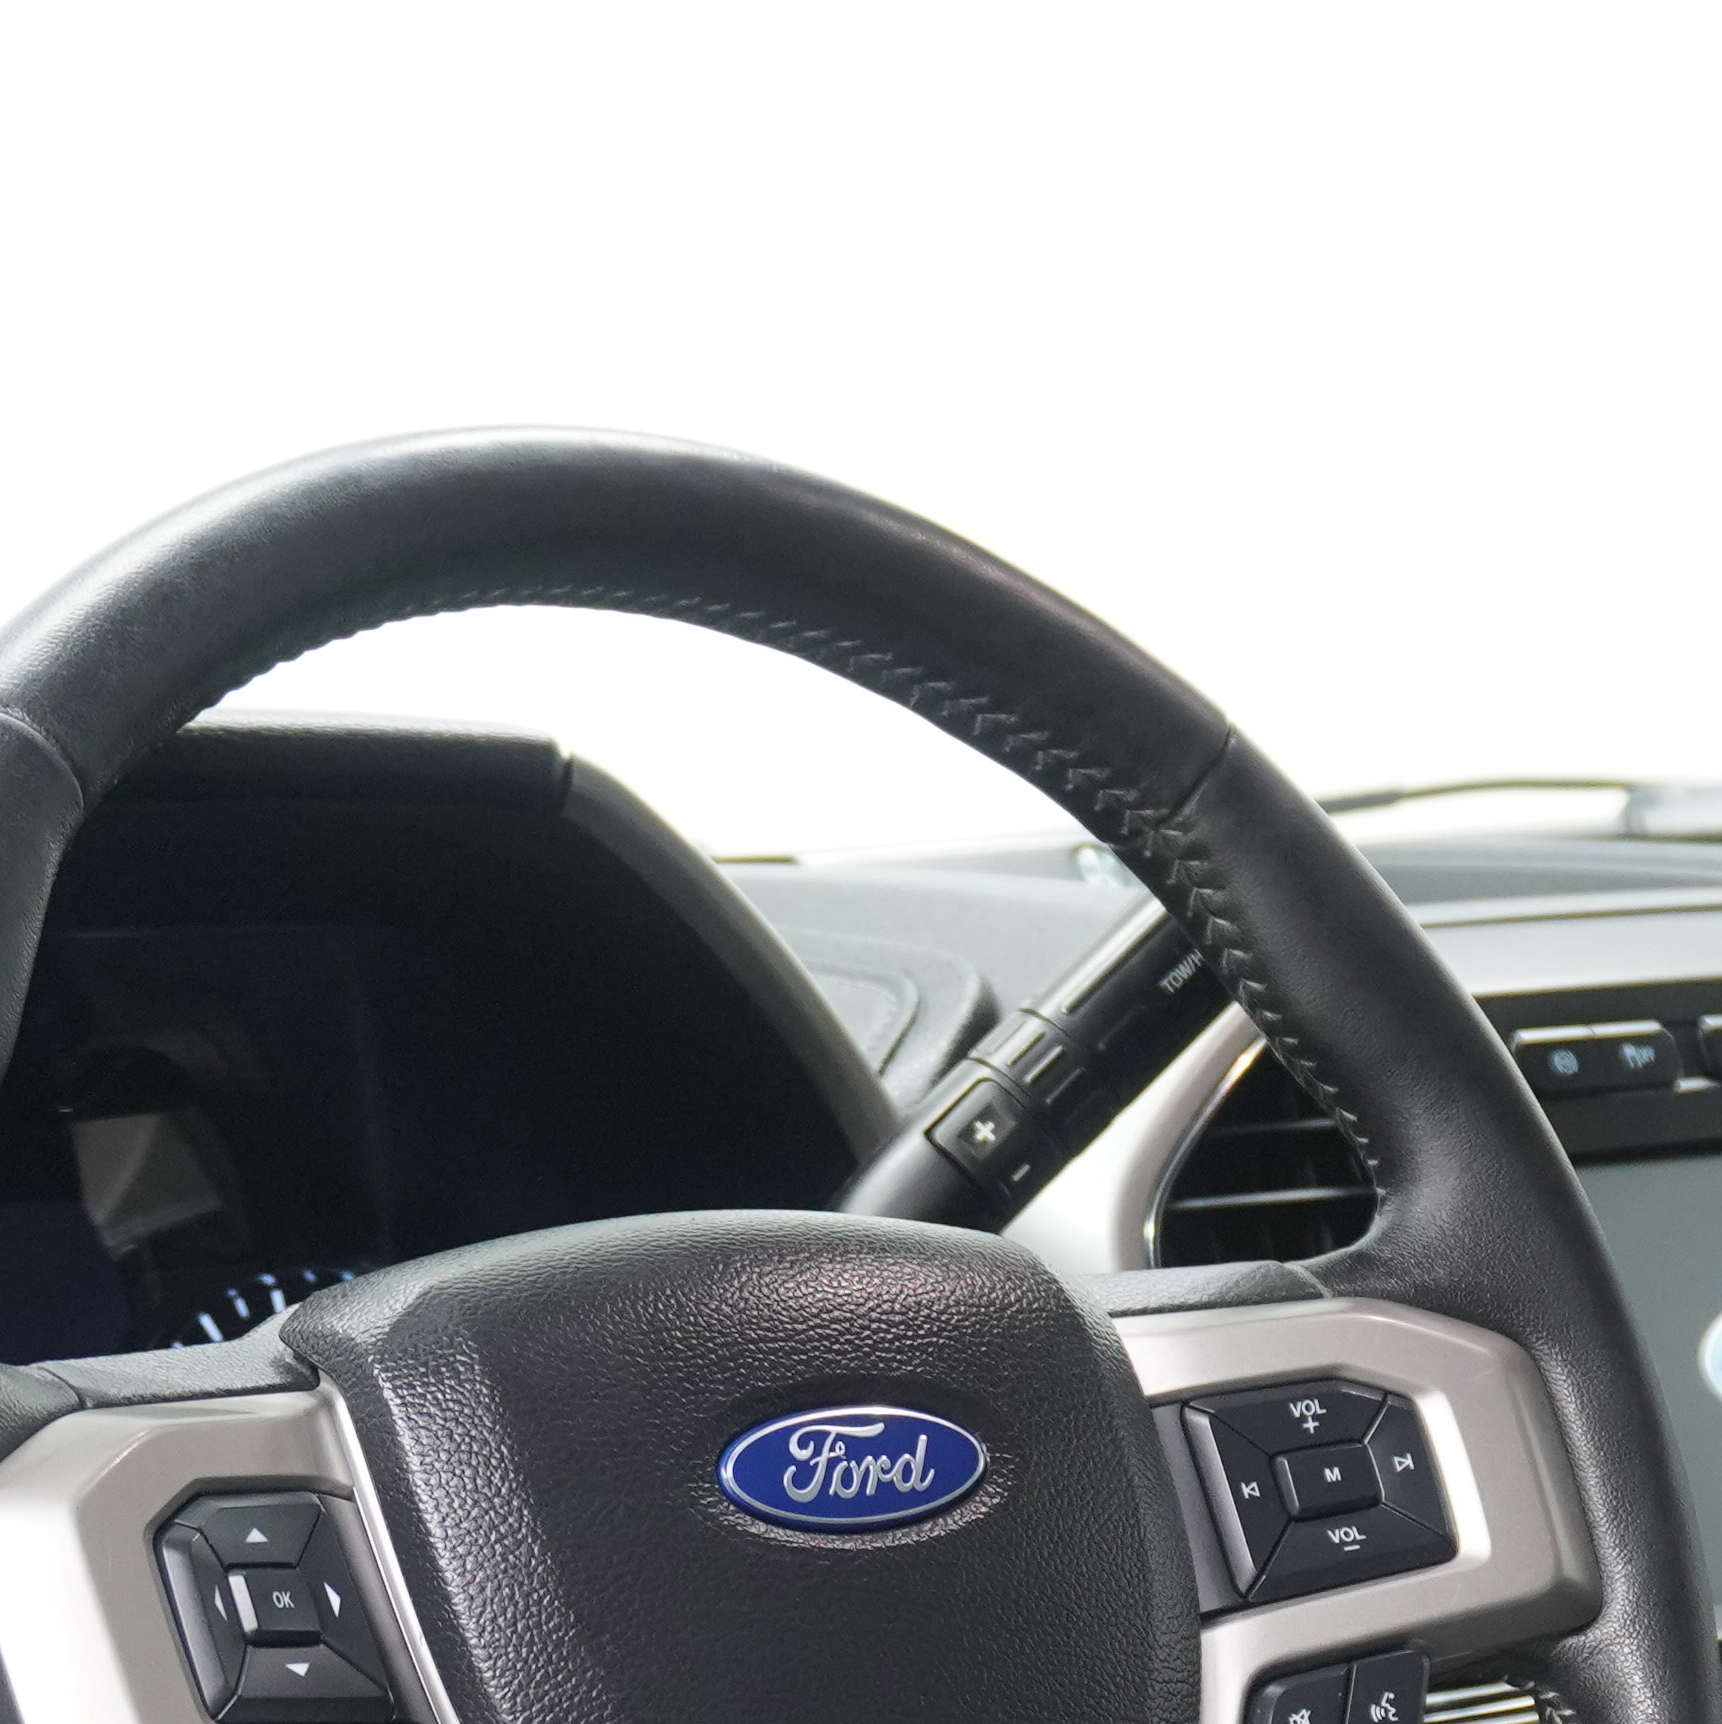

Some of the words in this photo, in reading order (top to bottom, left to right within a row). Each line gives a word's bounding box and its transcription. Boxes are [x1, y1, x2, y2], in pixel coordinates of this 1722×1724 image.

[1289, 1399, 1327, 1418] VOL
[783, 1422, 935, 1503] Ford
[1324, 1466, 1342, 1483] M
[1327, 1526, 1366, 1544] VOL
[272, 1591, 295, 1609] OK
